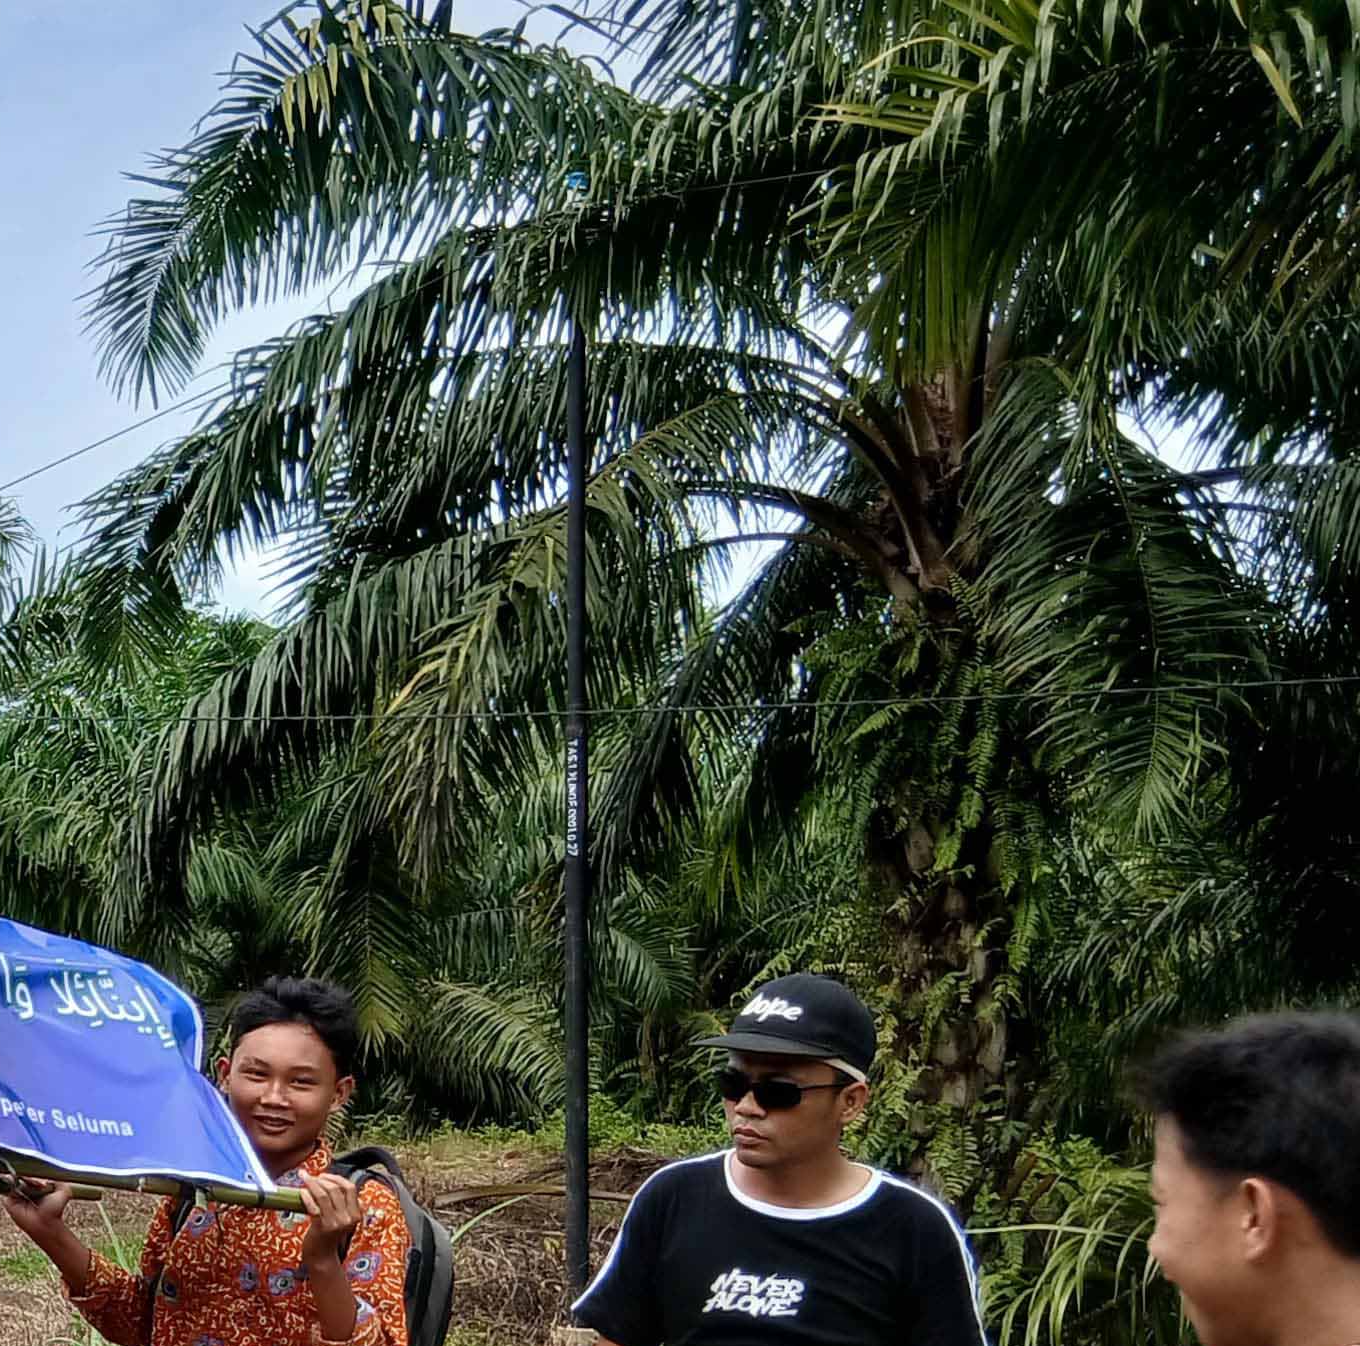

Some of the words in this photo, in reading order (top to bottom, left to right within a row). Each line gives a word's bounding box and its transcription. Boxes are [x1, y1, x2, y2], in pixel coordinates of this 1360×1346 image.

[53, 1108, 134, 1137] Seluma
[710, 1267, 805, 1302] NEVER
[702, 1290, 799, 1317] ALONE
